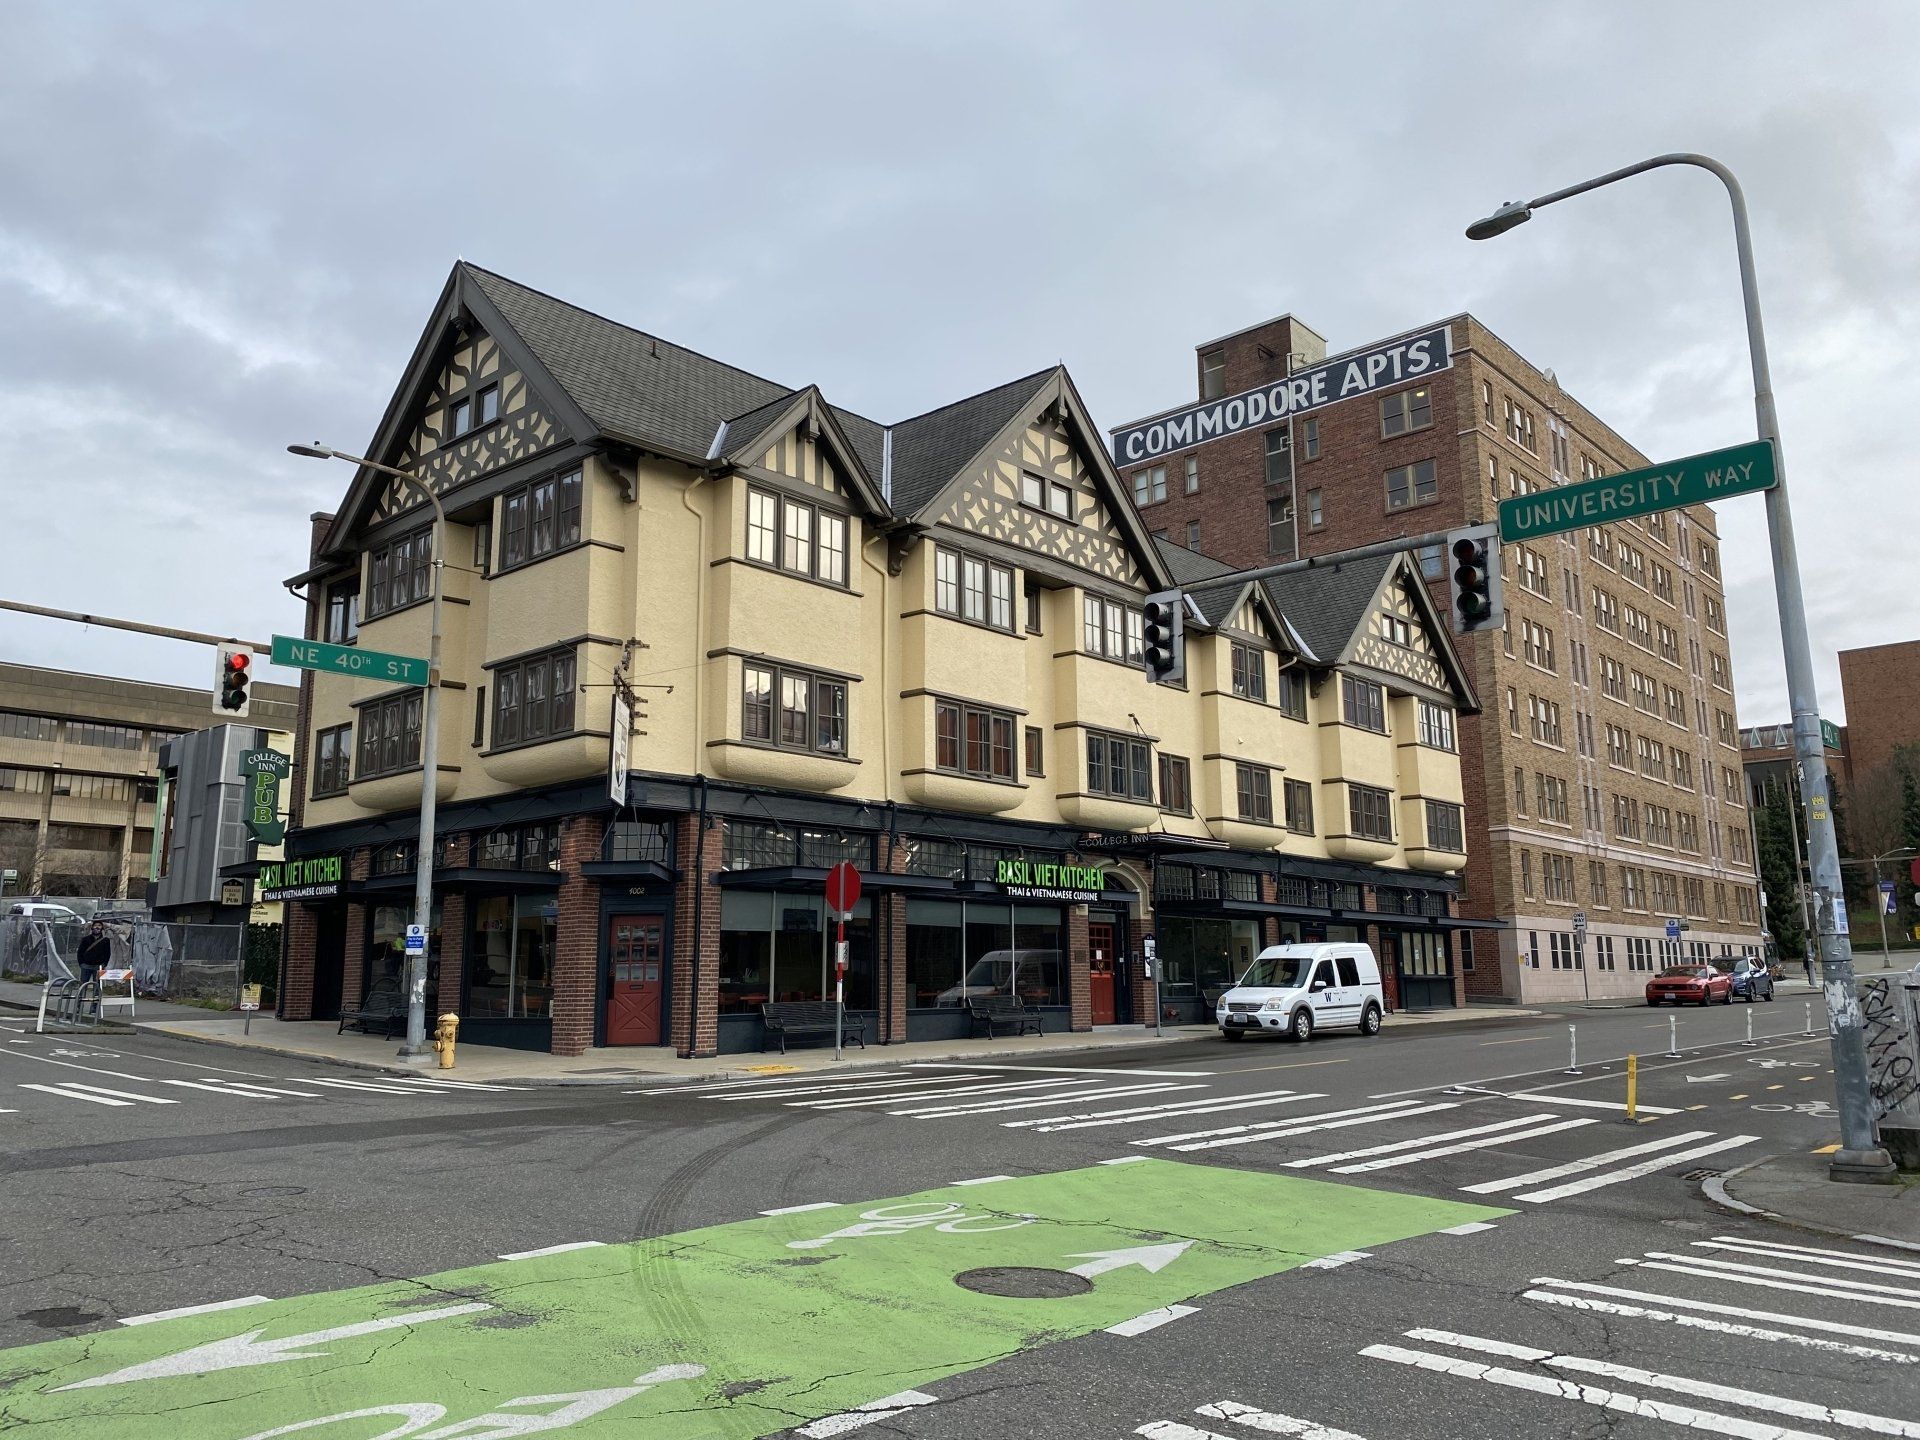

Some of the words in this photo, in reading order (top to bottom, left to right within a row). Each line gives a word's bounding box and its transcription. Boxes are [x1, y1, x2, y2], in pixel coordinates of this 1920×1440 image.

[1126, 371, 1328, 460] COMMODORE
[1340, 340, 1440, 396] APTS.
[1515, 471, 1686, 529] UNIVERSITY
[1705, 461, 1754, 489] WAY
[291, 645, 319, 663] NE
[387, 661, 412, 677] ST
[248, 753, 287, 767] COLLEGE
[258, 762, 276, 771] INN
[253, 771, 276, 824] PUB
[1085, 835, 1128, 847] COLLEGE
[1131, 833, 1150, 843] INN
[259, 864, 281, 889] BASIL
[285, 861, 303, 886] VIET
[304, 856, 342, 884] KITCHEN
[998, 860, 1032, 885] BASIL
[1034, 863, 1059, 887] VIET
[1059, 865, 1105, 890] KITCHEN
[265, 892, 276, 900] THAI
[283, 887, 315, 899] VIETNAMESE
[315, 885, 337, 895] CUISINE
[1007, 886, 1025, 896] THAI
[1026, 888, 1031, 896] &
[1031, 888, 1073, 900] VIETNAMESE
[1073, 890, 1098, 901] CUISINE
[1324, 992, 1332, 1002] W
